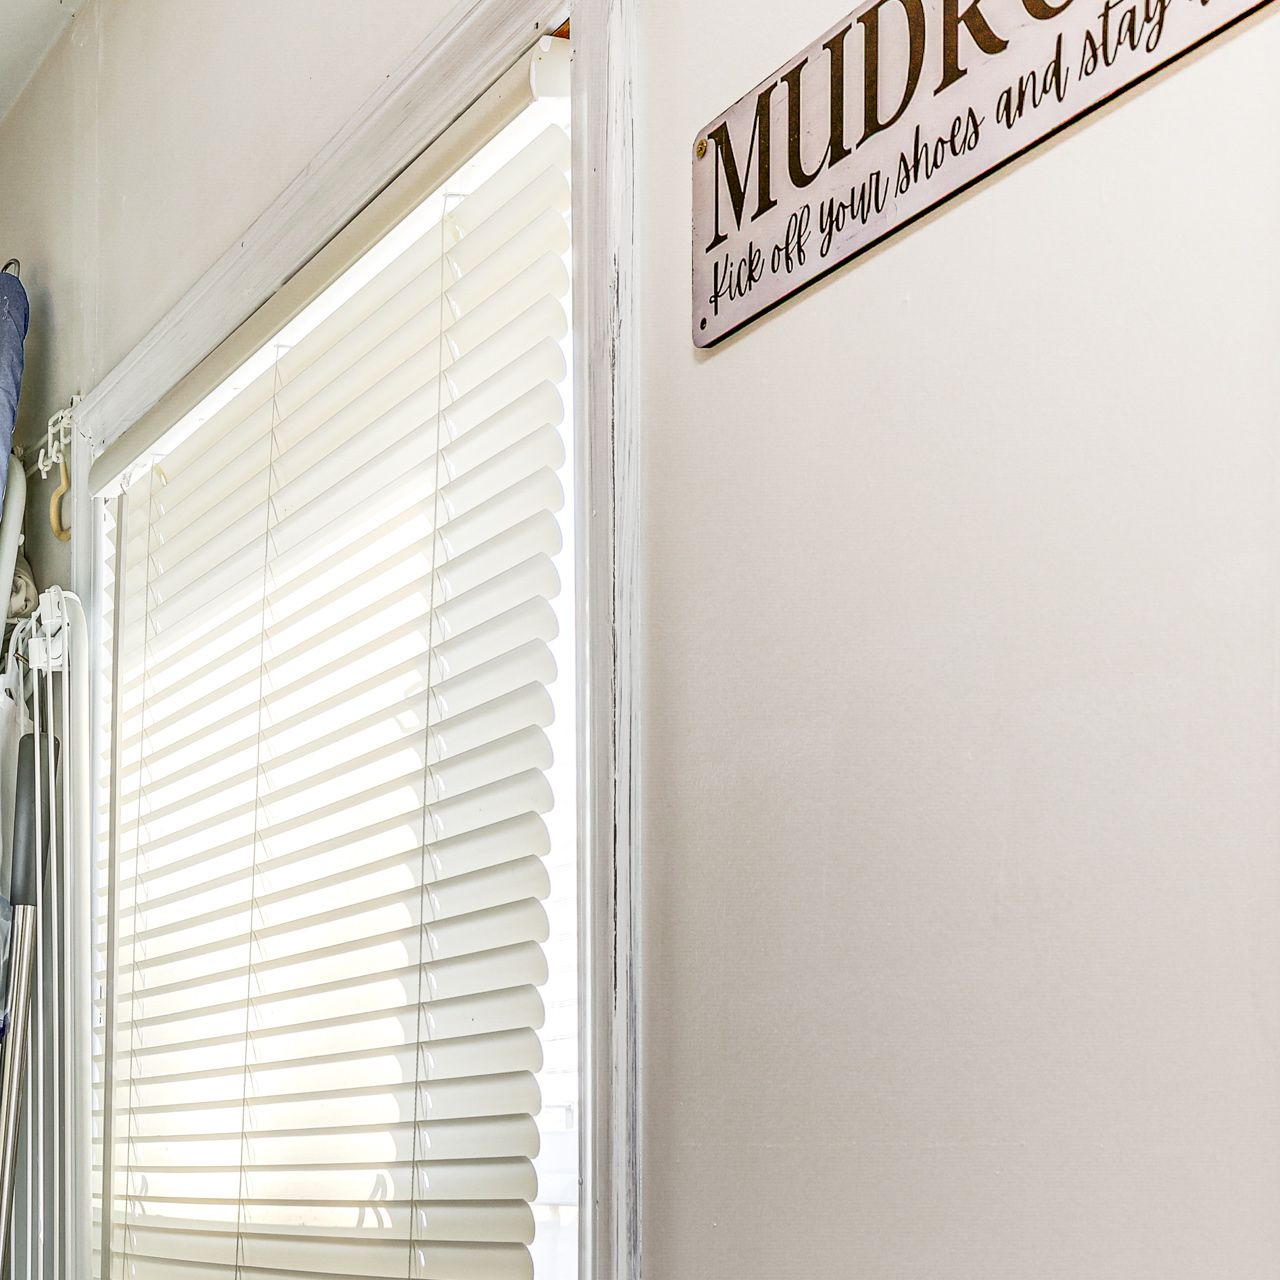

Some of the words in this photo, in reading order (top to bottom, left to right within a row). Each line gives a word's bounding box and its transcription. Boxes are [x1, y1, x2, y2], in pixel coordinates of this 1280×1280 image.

[705, 0, 1074, 252] MUDR
[709, 241, 766, 315] Kick
[770, 205, 811, 274] off
[819, 171, 890, 258] your
[894, 108, 986, 198] shoes
[995, 33, 1070, 129] and
